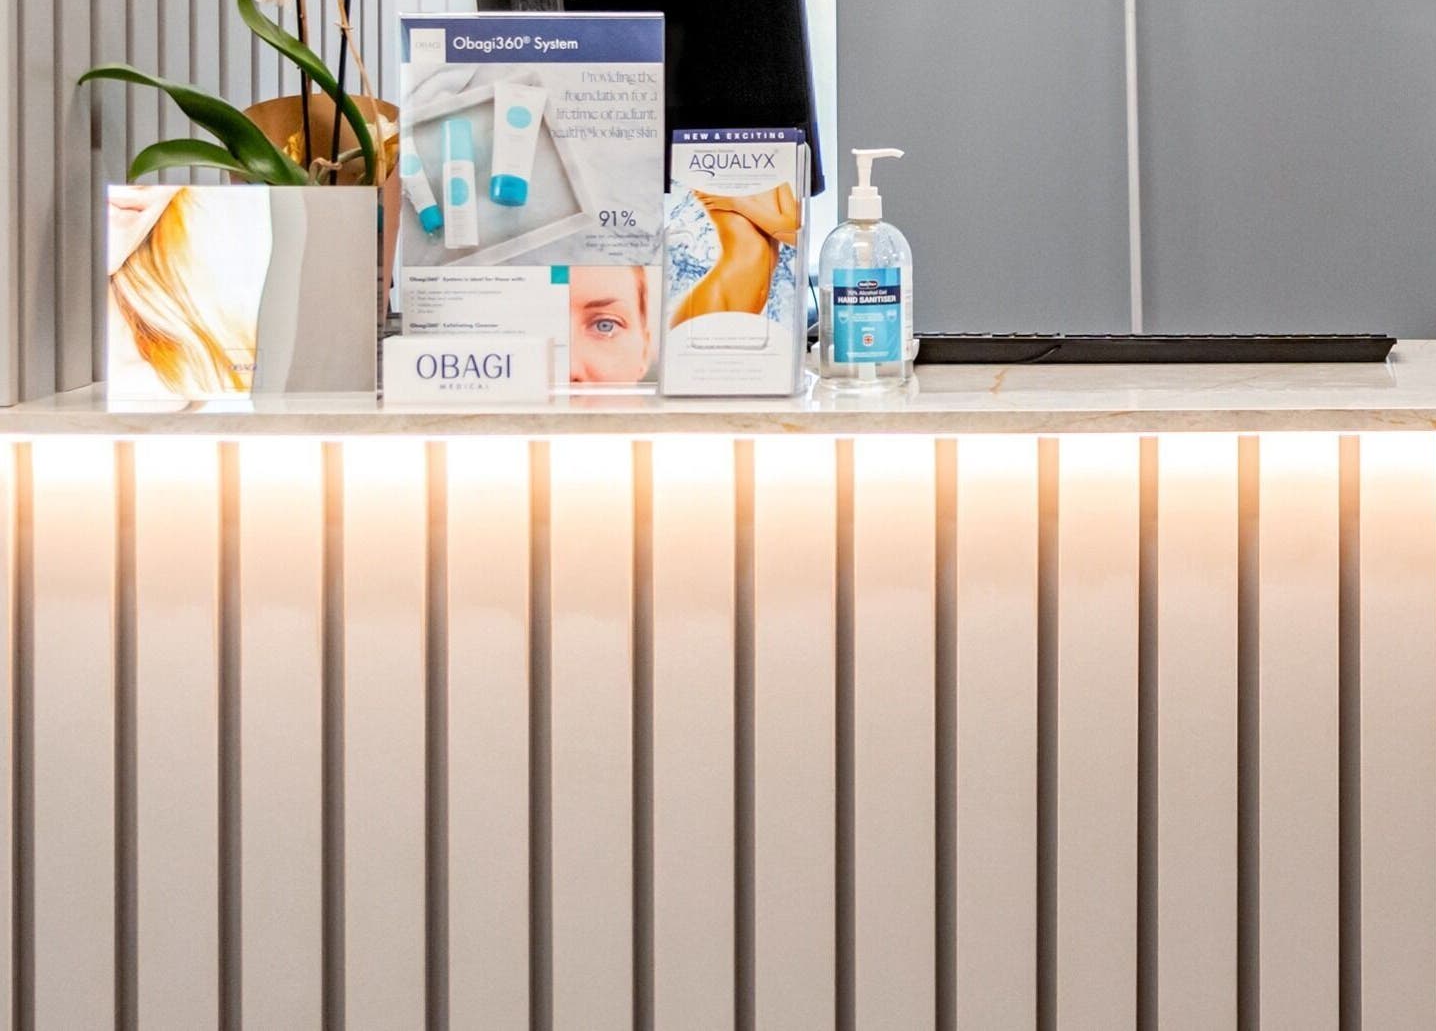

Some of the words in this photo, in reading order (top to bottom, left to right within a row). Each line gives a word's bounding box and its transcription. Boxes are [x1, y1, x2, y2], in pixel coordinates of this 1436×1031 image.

[534, 37, 579, 53] System
[683, 132, 709, 141] NEW
[714, 132, 721, 140] &
[726, 131, 785, 140] EXCITING
[688, 153, 775, 170] AQUALYX
[599, 210, 637, 227] 91%
[859, 295, 897, 303] SANITISER
[416, 353, 511, 380] OBAGI
